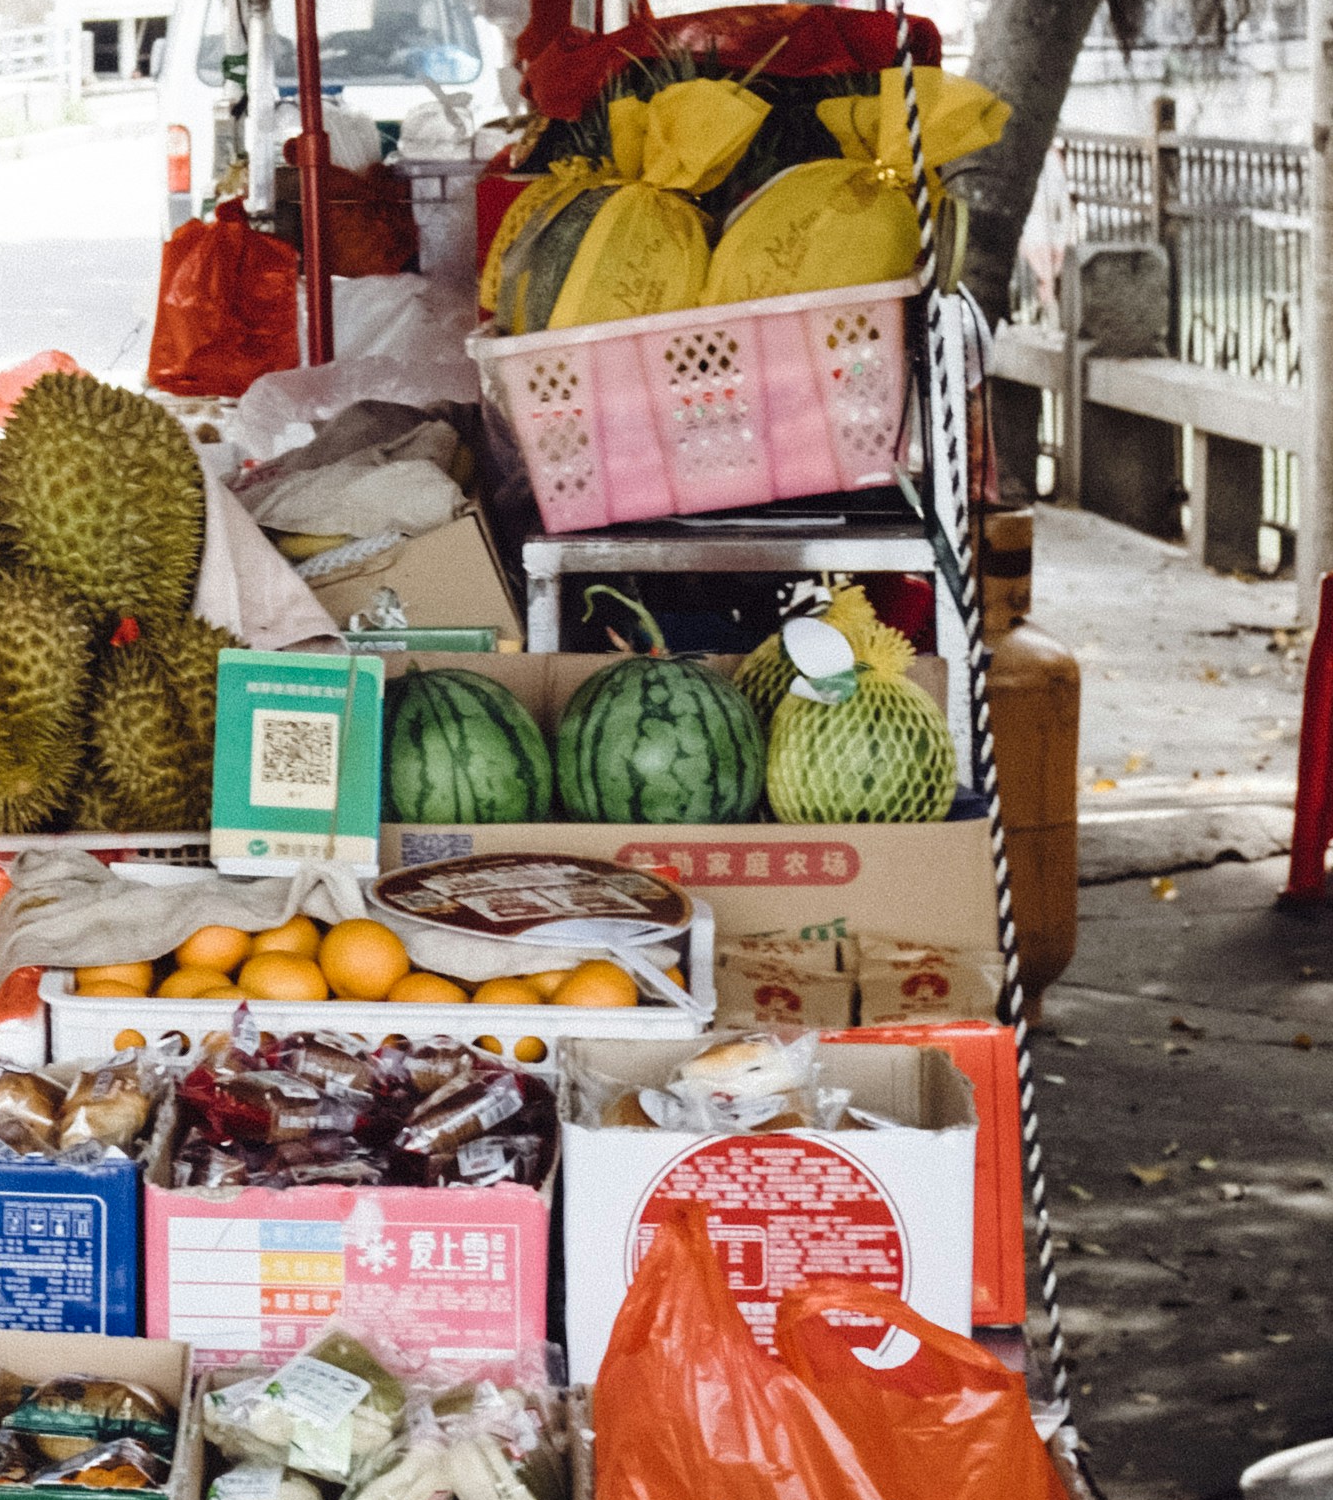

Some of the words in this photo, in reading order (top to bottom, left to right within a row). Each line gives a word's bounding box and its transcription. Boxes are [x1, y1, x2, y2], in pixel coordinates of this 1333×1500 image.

[275, 843, 334, 860] 微信支
[409, 1231, 489, 1271] 爱上雪
